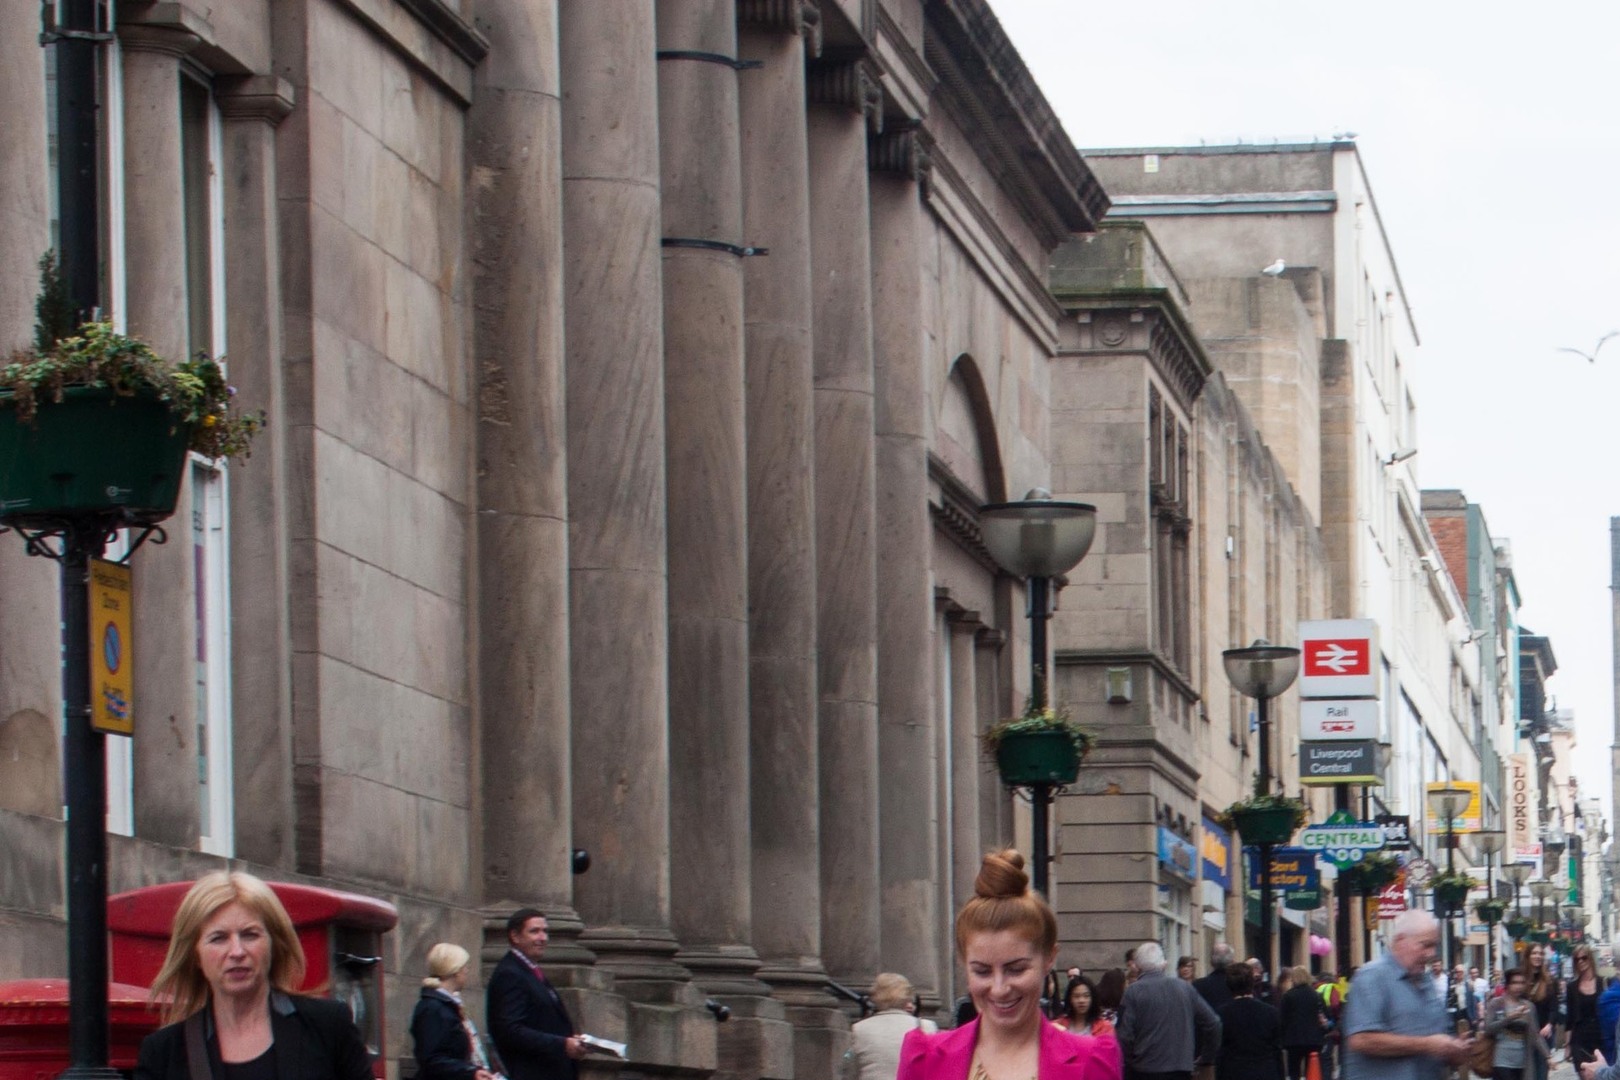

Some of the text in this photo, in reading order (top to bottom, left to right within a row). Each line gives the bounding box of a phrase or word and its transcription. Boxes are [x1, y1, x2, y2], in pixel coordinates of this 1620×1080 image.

[1326, 707, 1348, 717] Rail
[1310, 748, 1363, 761] Liverpool
[1310, 763, 1352, 773] Central
[1513, 766, 1527, 832] LOOKS
[1303, 832, 1381, 846] CENTRAL
